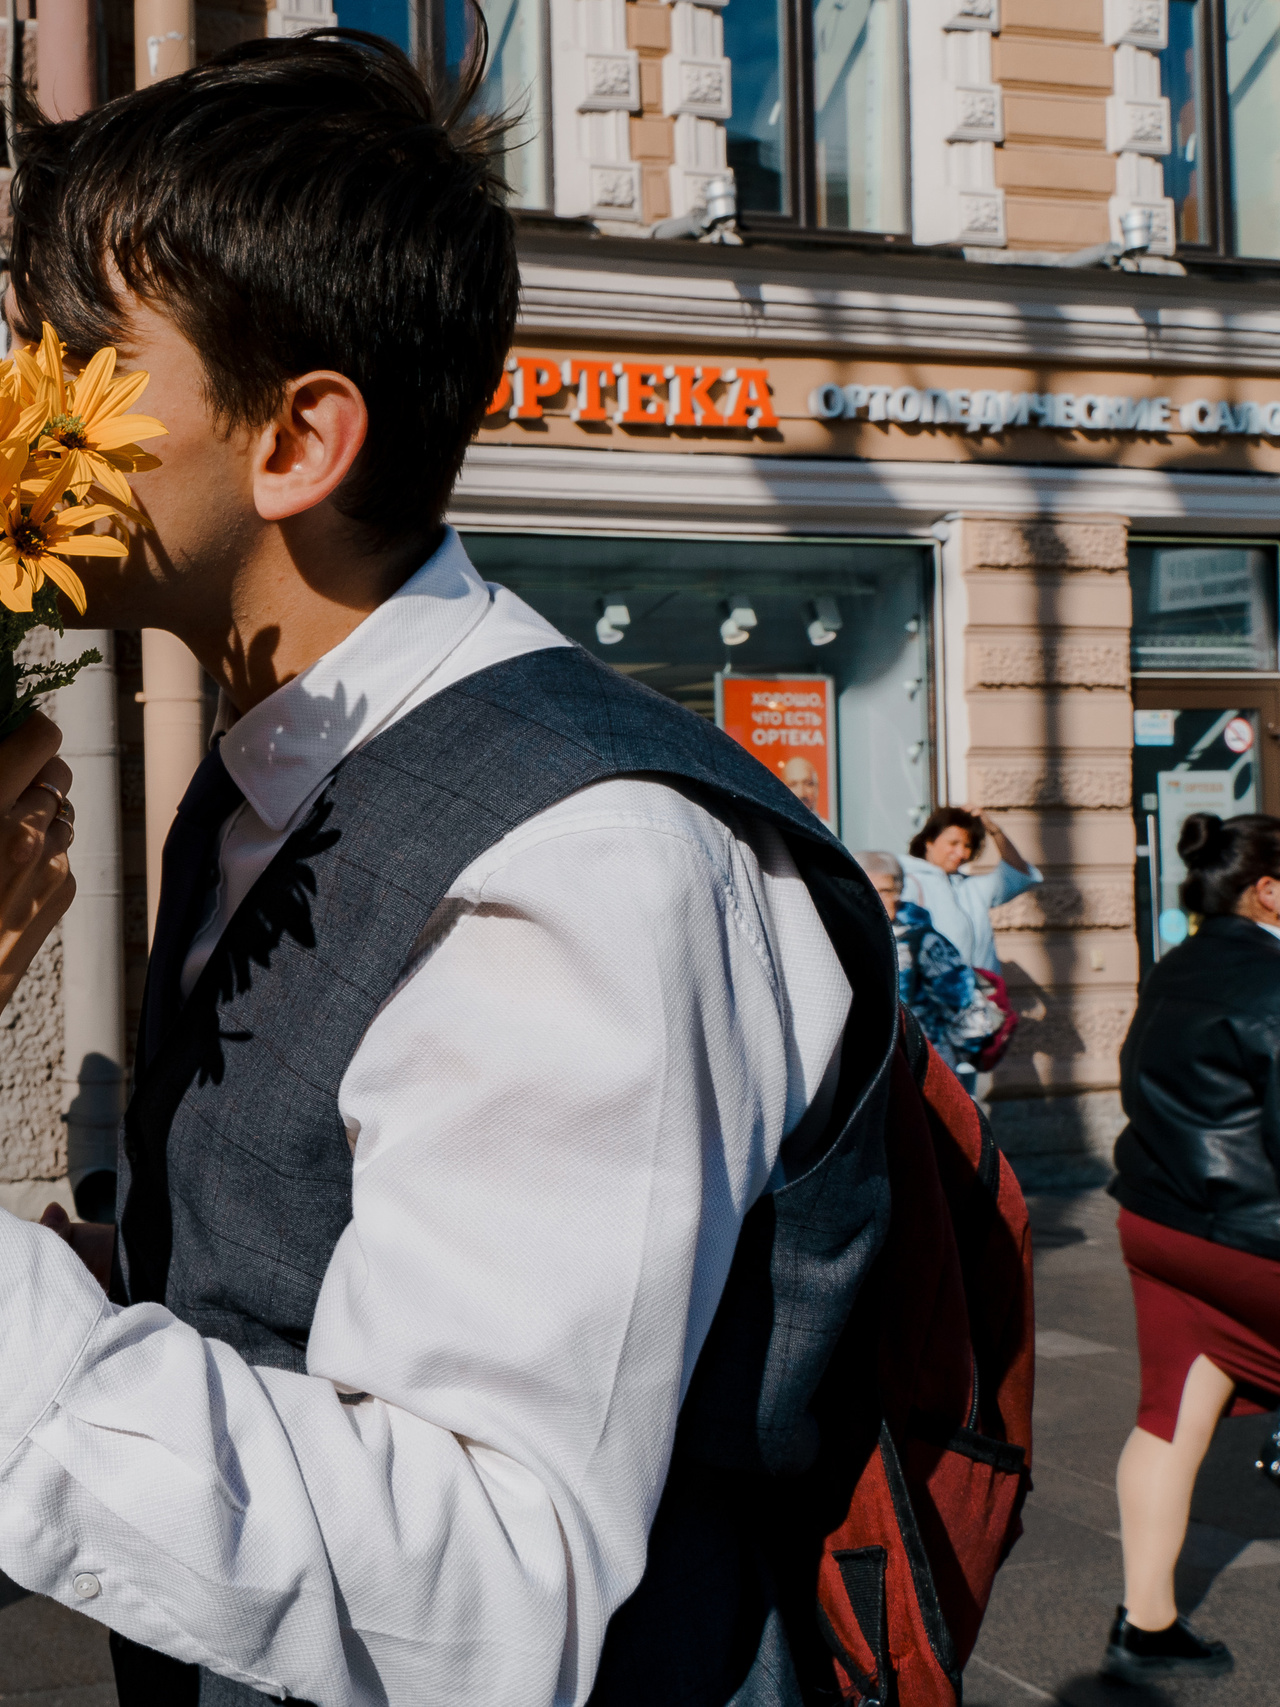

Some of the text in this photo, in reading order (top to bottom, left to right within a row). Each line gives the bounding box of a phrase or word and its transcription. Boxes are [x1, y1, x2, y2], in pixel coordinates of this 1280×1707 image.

[808, 382, 1171, 433] ОРТОПЕДИЧЕСКИЕ
[751, 691, 825, 709] ХОРОШО,
[751, 711, 823, 726] ЧТО ЕСТЬ
[751, 728, 825, 746] ОРТЕКА
